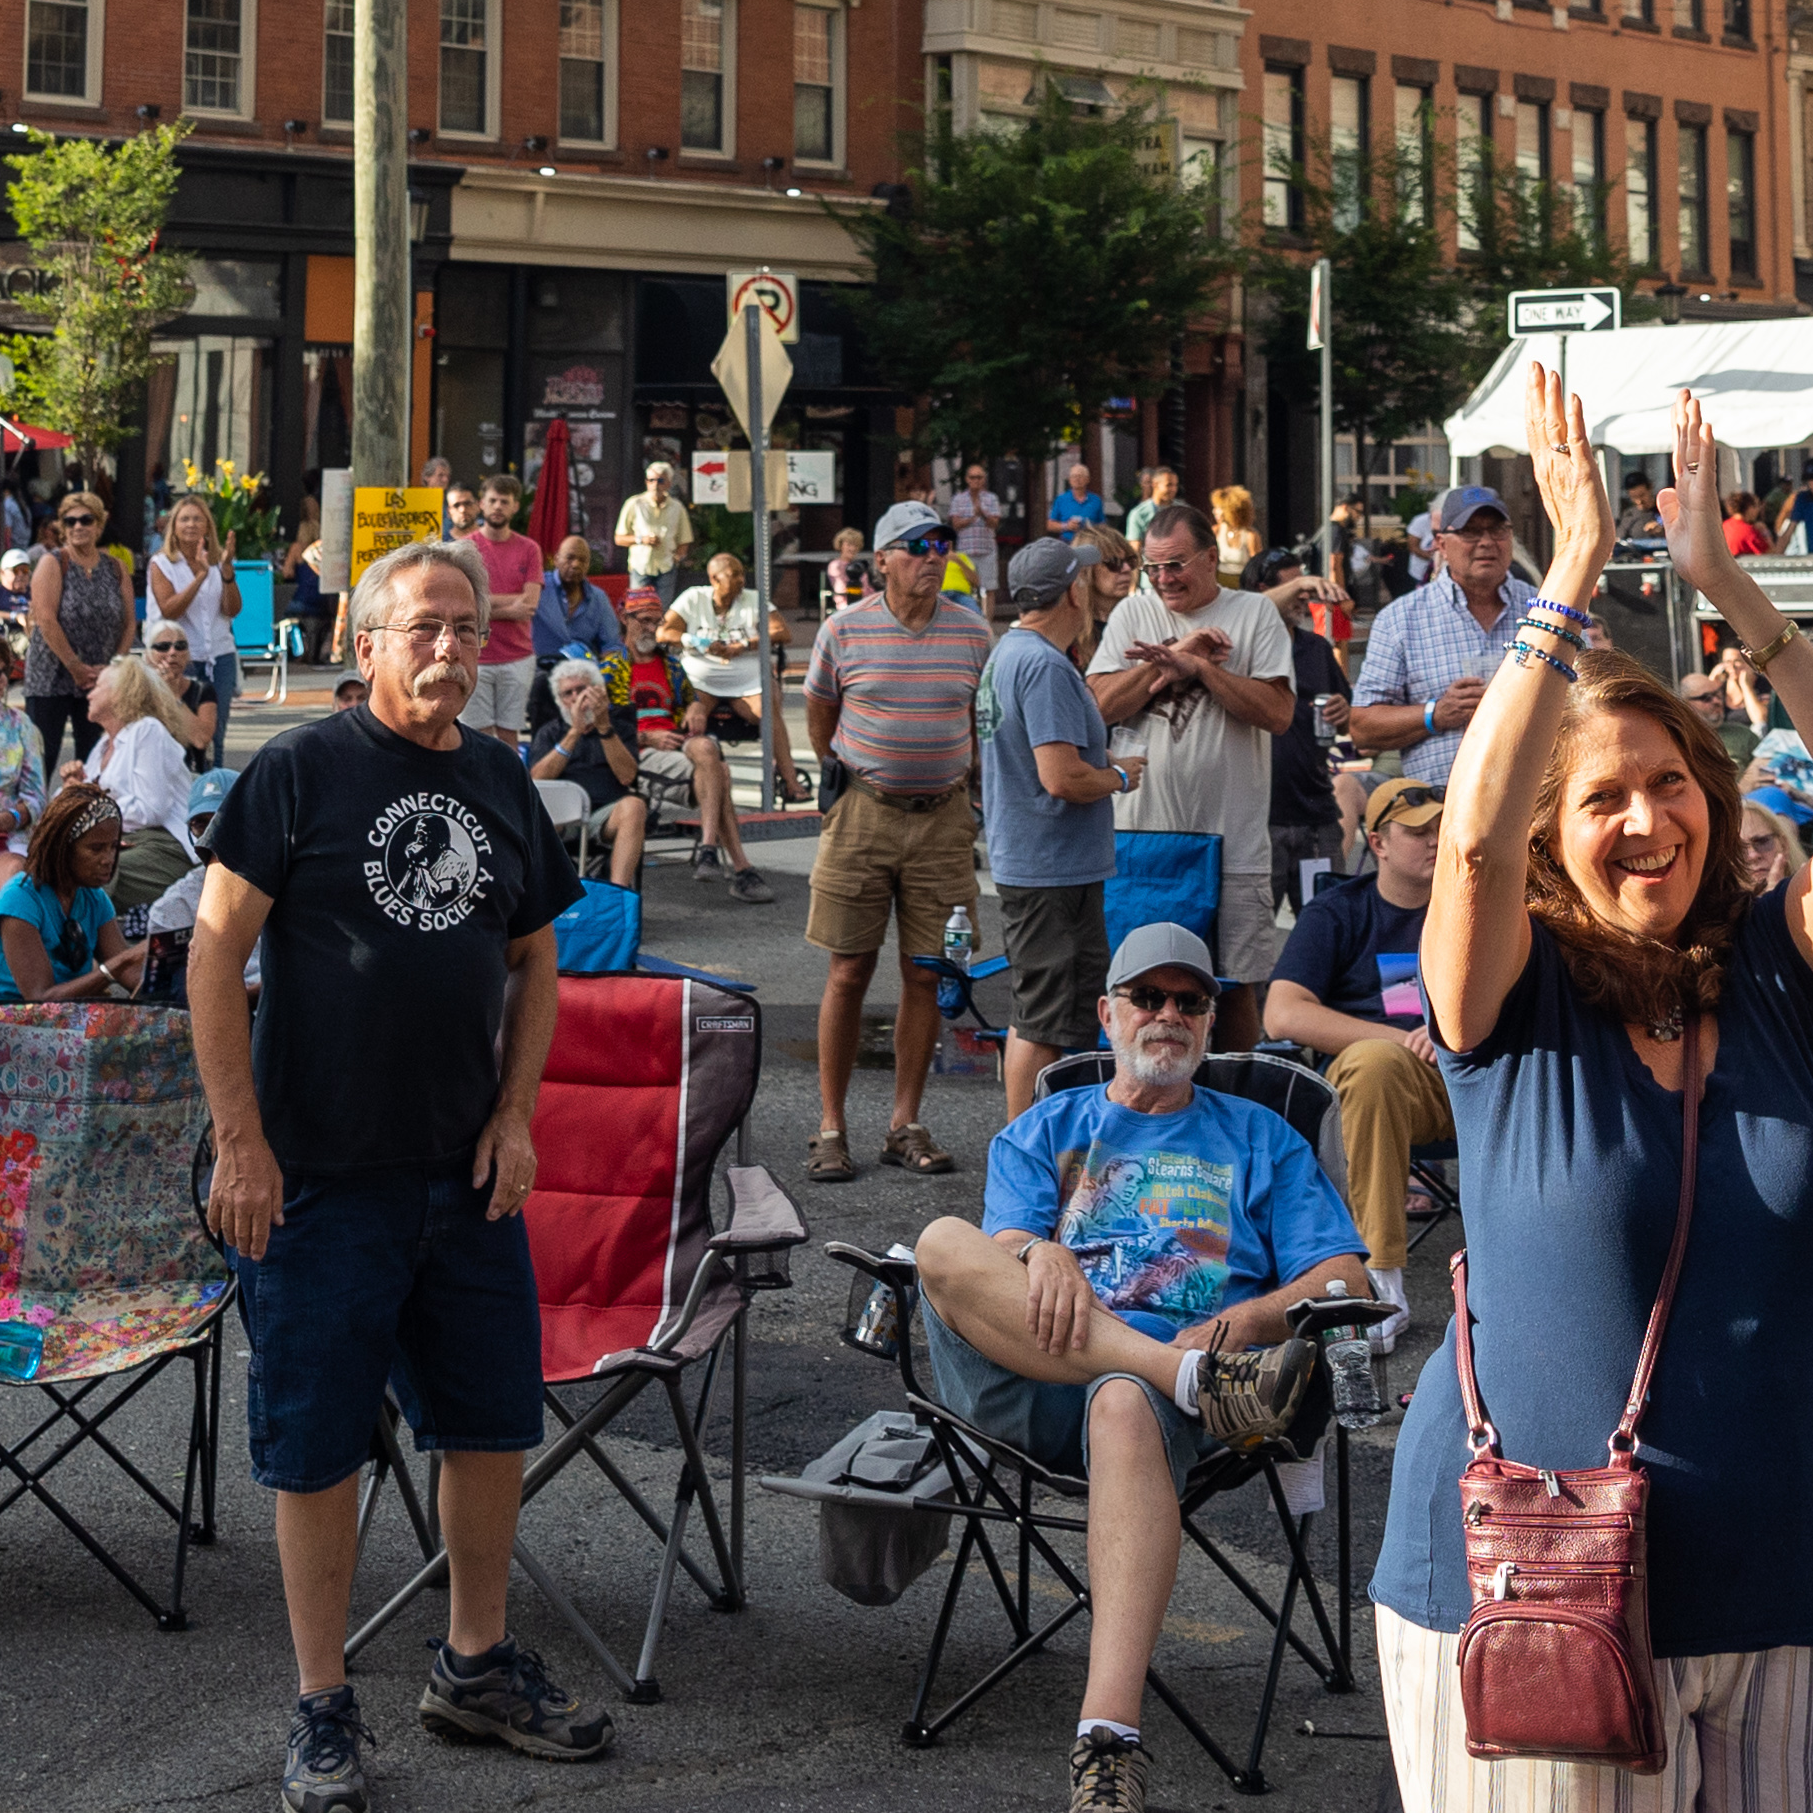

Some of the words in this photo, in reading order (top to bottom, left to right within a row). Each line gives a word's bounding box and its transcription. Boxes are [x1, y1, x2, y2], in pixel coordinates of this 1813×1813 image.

[1524, 306, 1548, 322] ONE
[1555, 305, 1583, 320] WAY
[368, 792, 493, 855] CONNECTICUT
[363, 860, 415, 926] BLUES
[418, 867, 495, 932] SOCIETY
[700, 1020, 750, 1029] CRAFTSMAN
[1147, 1157, 1194, 1177] Stearns
[1197, 1165, 1233, 1191] Square
[1138, 1197, 1171, 1216] FAT
